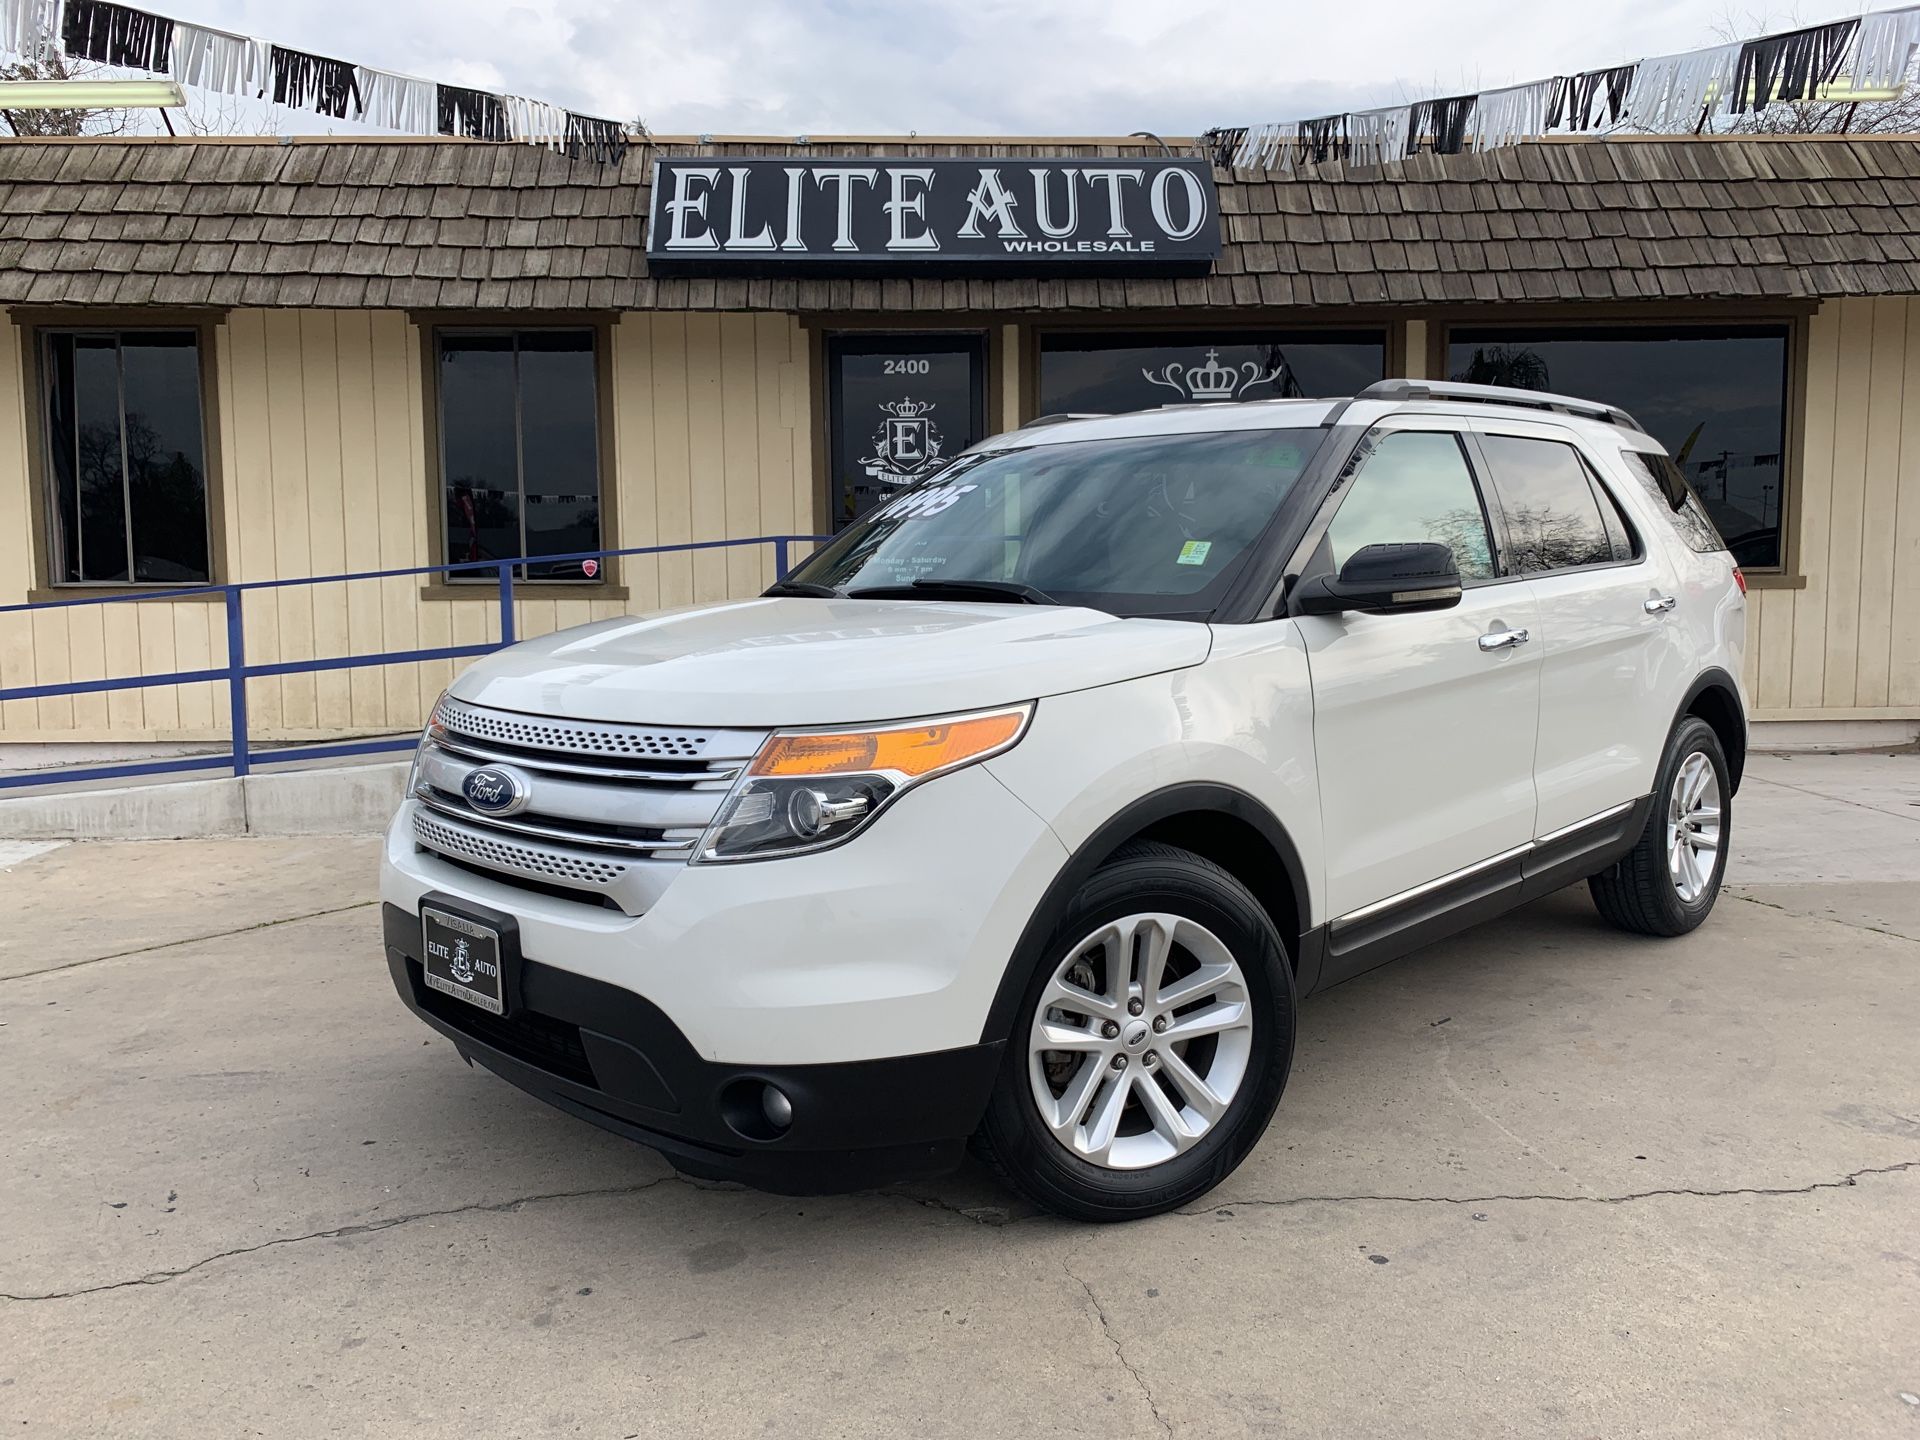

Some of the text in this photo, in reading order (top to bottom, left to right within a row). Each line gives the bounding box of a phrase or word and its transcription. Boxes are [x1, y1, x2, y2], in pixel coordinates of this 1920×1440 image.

[664, 166, 1207, 252] ELITE AUTO
[1003, 241, 1155, 253] WHOLESALE
[884, 360, 930, 374] 2400
[881, 473, 906, 484] ELITE
[911, 556, 947, 565] Saturday
[470, 773, 503, 803] Ford
[428, 940, 449, 959] ELITE
[474, 959, 497, 978] AUTO
